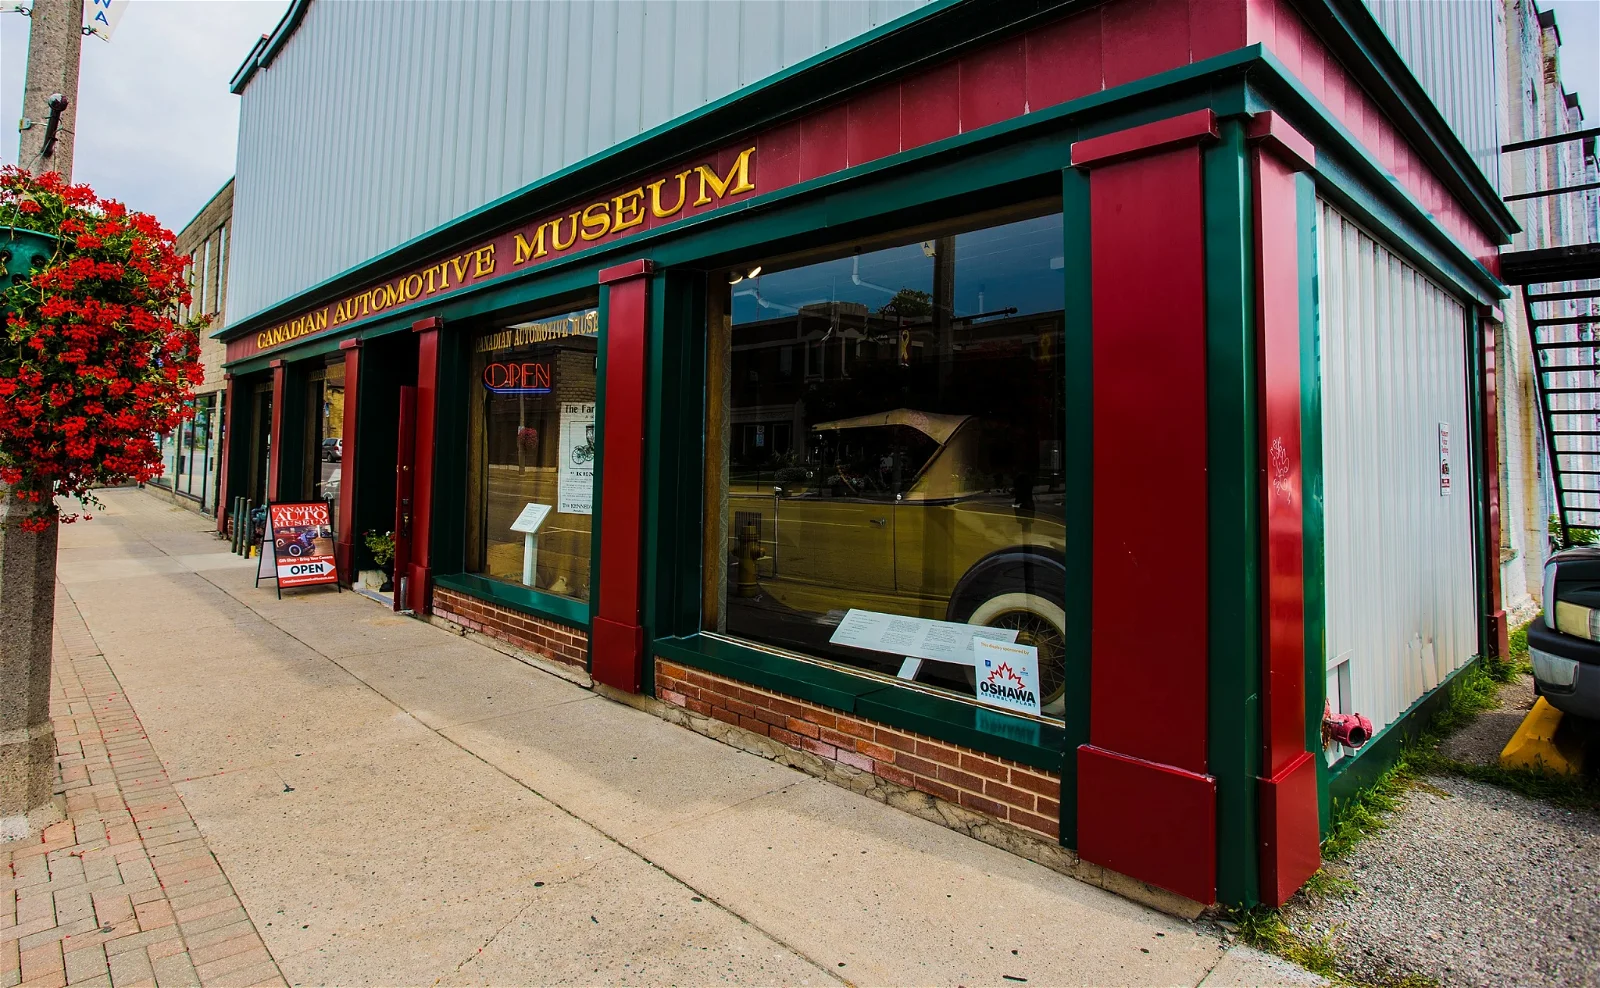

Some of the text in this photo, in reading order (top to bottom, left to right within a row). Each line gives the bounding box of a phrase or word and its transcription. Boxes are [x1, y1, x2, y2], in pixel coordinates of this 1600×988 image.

[257, 146, 757, 349] CANADIAN AUTOMOTIVE MUSEUM
[475, 330, 513, 354] CANADIAN
[513, 318, 569, 347] AUTOMOTIVE
[484, 363, 551, 388] OPEN
[565, 404, 578, 414] The
[272, 505, 327, 513] CANADIAN
[274, 510, 328, 522] AUTO
[274, 519, 329, 528] MUSEUM
[290, 563, 324, 575] OPEN
[980, 681, 1036, 704] OSHAWA
[981, 692, 1012, 702] ASSEMBLY
